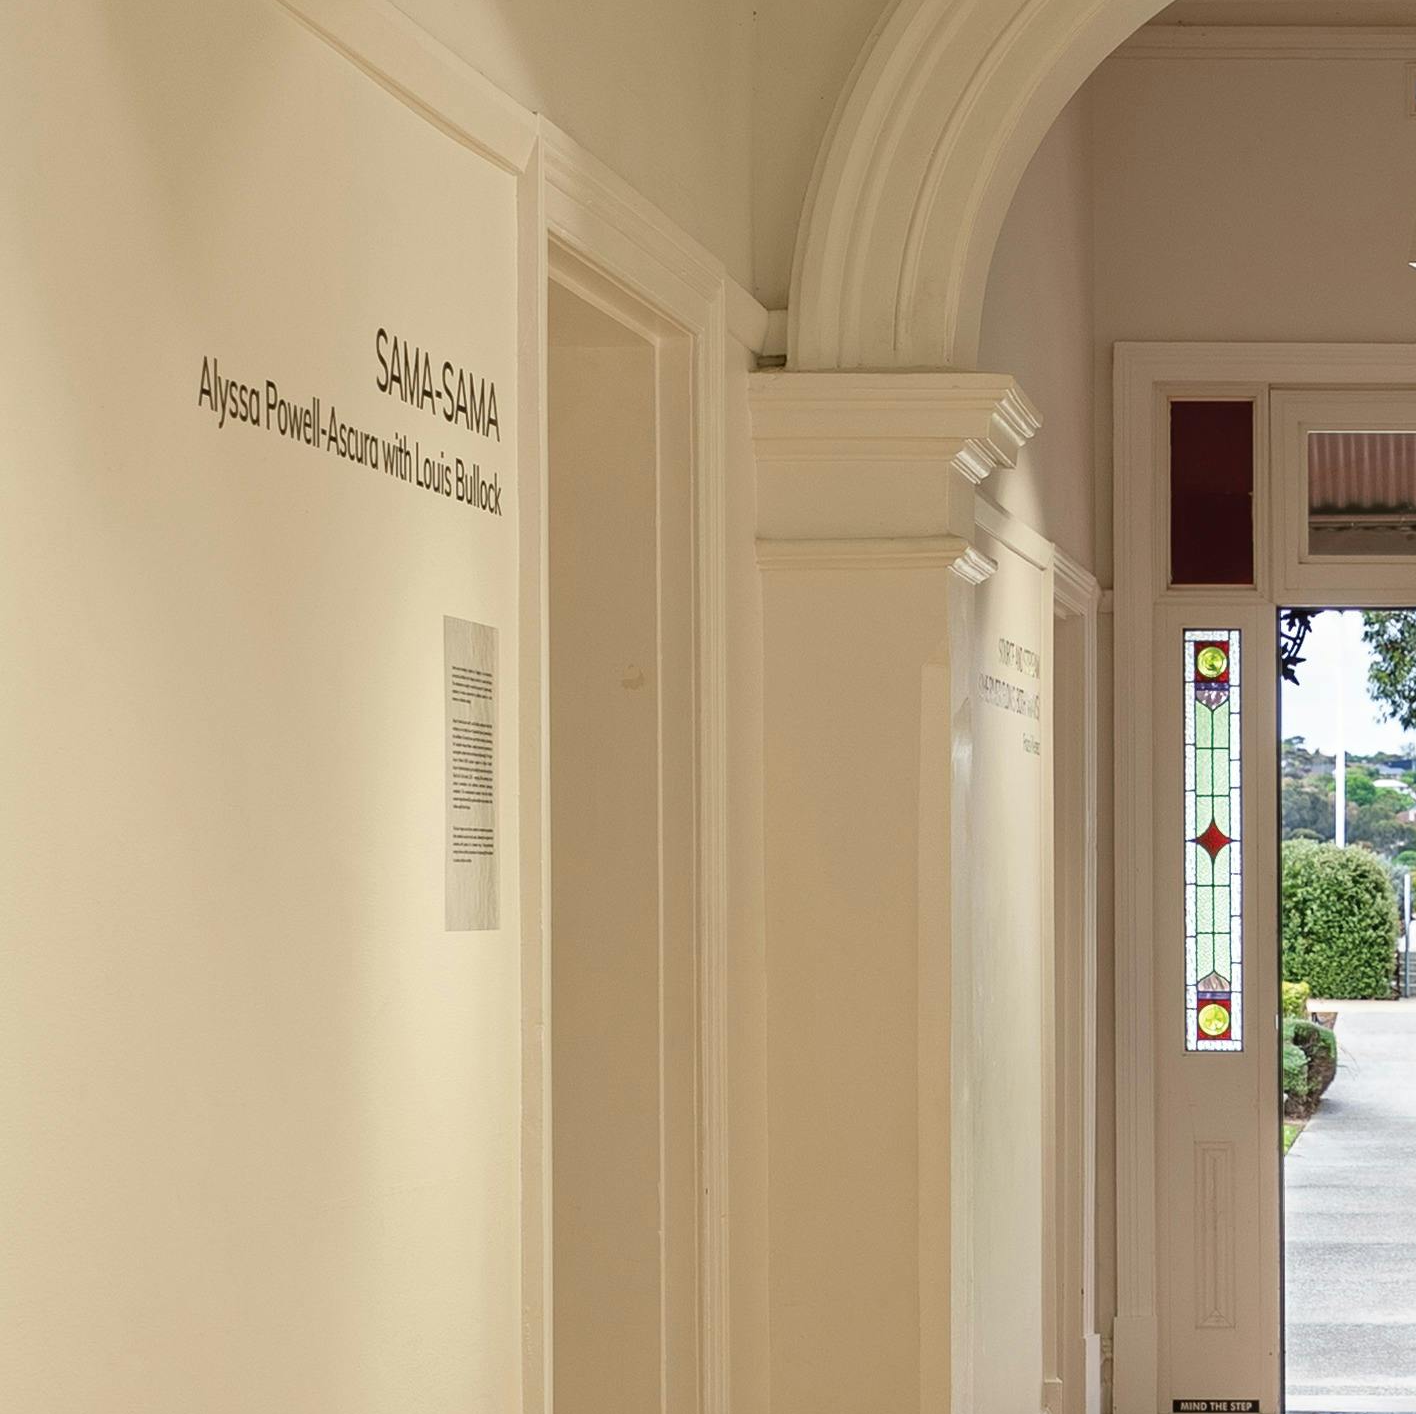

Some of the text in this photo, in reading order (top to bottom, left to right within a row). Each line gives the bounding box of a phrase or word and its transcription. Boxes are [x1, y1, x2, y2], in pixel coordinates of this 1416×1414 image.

[198, 355, 503, 516] Alyssa Powell-Ascura with Louis Bullock
[375, 328, 501, 442] SAMA-SAMA
[1180, 1402, 1253, 1411] MIND THE STEP
